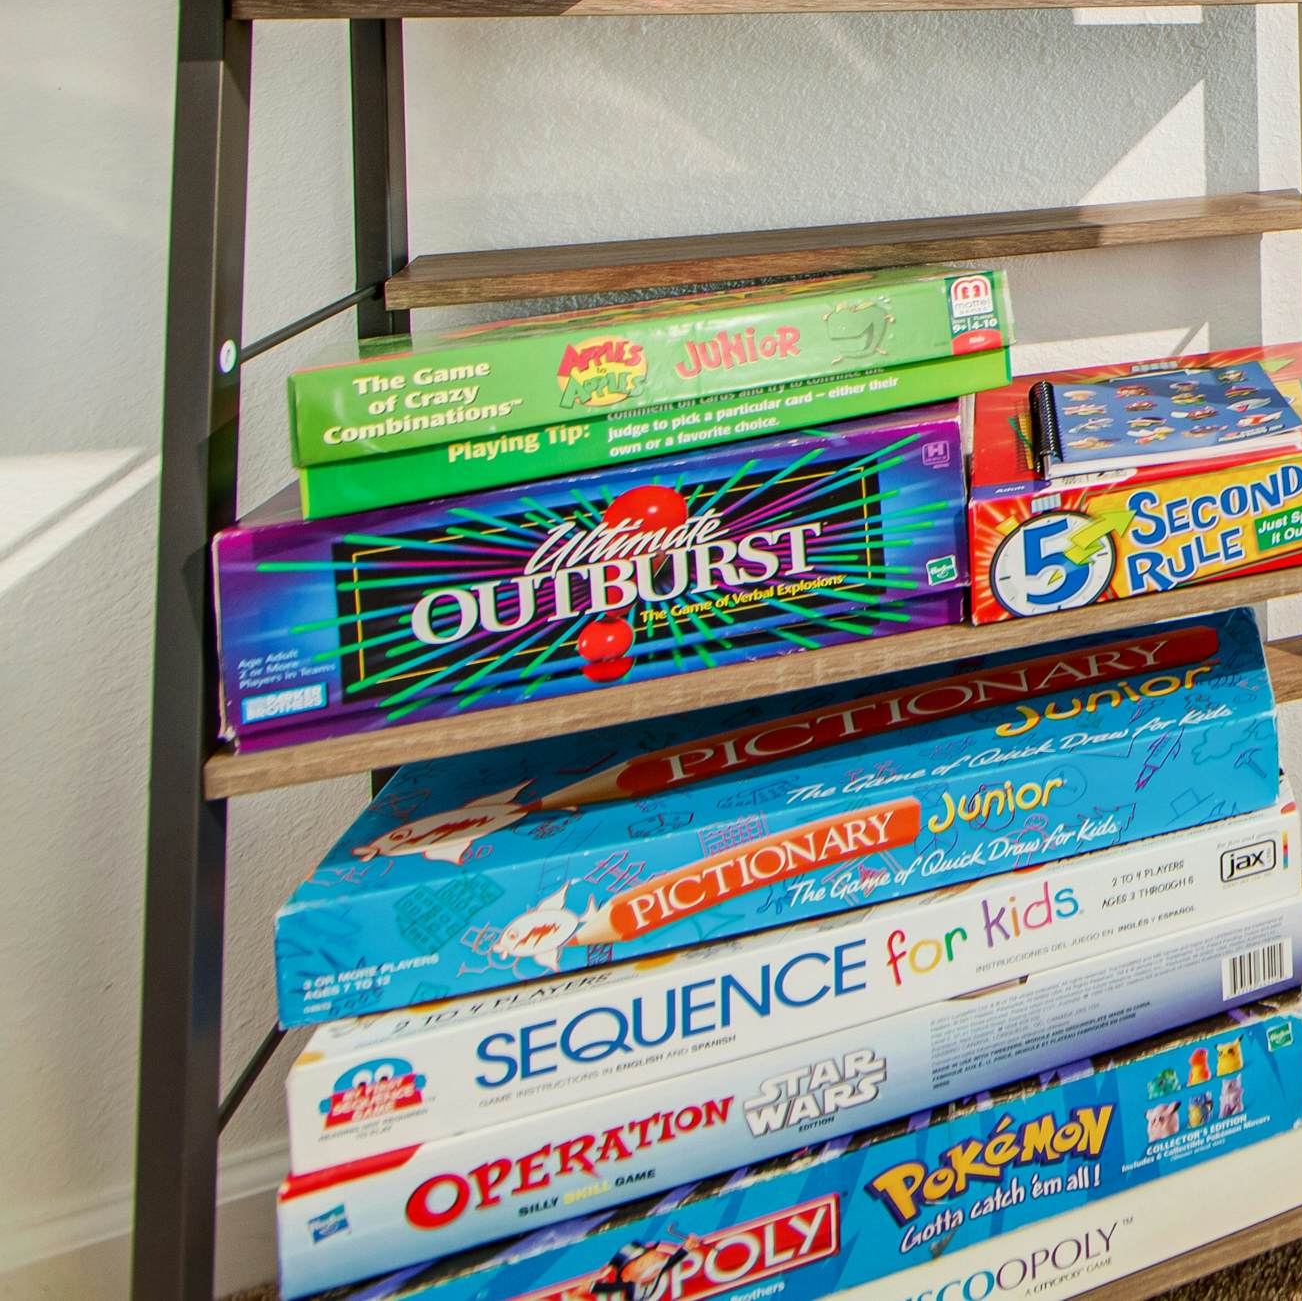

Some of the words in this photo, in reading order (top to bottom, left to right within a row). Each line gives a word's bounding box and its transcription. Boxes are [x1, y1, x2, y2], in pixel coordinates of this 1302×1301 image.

[353, 374, 406, 397] The
[413, 362, 492, 390] Game
[557, 341, 644, 377] APPLES
[368, 394, 398, 417] of
[404, 383, 479, 411] Crazy
[608, 424, 649, 443] judge
[653, 419, 669, 431] to
[672, 411, 700, 431] pick
[717, 398, 781, 427] particular
[784, 391, 814, 408] card
[828, 383, 866, 399] either
[869, 376, 900, 392] their
[447, 423, 540, 463] Playing
[544, 410, 592, 446] Tip:
[609, 442, 641, 458] own
[645, 436, 662, 450] or
[677, 425, 732, 445] favorite
[734, 416, 780, 434] choice.
[524, 508, 730, 579] Ultimate
[1258, 515, 1289, 535] Just
[412, 522, 824, 647] OUTBURST
[1023, 518, 1091, 606] 5
[1127, 528, 1246, 594] RULE
[640, 607, 660, 623] The
[670, 600, 714, 616] Game
[715, 595, 731, 610] of
[732, 585, 774, 604] Verbal
[776, 574, 846, 596] Explosions
[666, 640, 1169, 784] PICTIONARY
[995, 666, 1213, 738] Junior
[787, 782, 836, 804] The
[842, 766, 927, 796] Game
[969, 741, 1057, 769] Quick
[1060, 728, 1129, 751] Draw
[928, 778, 1064, 834] Junior
[627, 809, 899, 930] PICTIONARY
[787, 882, 829, 909] The
[829, 870, 892, 901] Game
[891, 861, 918, 890] of
[918, 845, 985, 881] Quick
[987, 835, 1040, 863] Draw
[1040, 827, 1077, 857] for
[1102, 895, 1127, 909] AGES
[1139, 876, 1186, 898] THROUGH
[1144, 860, 1185, 878] PLAYERS
[1227, 848, 1265, 879] jax
[337, 966, 378, 984] MORE
[379, 954, 440, 975] PLAYERS
[975, 947, 1050, 974] INSTRUCCIONES
[1051, 941, 1069, 954] DEL
[1070, 932, 1100, 950] JUEGO
[1157, 904, 1195, 921] ESPAÑOL
[475, 939, 867, 1089] SEQUENCE
[885, 926, 967, 986] for
[981, 880, 1081, 948] kids
[478, 1093, 512, 1108] GAME
[515, 1068, 600, 1099] INSTRUCTIONS
[615, 1053, 664, 1073] ENGLISH
[666, 1047, 689, 1061] AND
[690, 1033, 737, 1054] SPANISH
[743, 1049, 887, 1109] STAR
[745, 1071, 887, 1137] WARS
[798, 1115, 834, 1133] EDITION
[405, 1096, 735, 1232] OPERATION
[1145, 1128, 1207, 1156] COLLECTOR'S
[1209, 1113, 1248, 1132] EDITION
[518, 1196, 559, 1217] SILLY
[614, 1168, 656, 1188] GAME
[900, 1209, 963, 1254] Gotta
[970, 1180, 1026, 1219] catch
[1086, 1258, 1112, 1273] GAME
